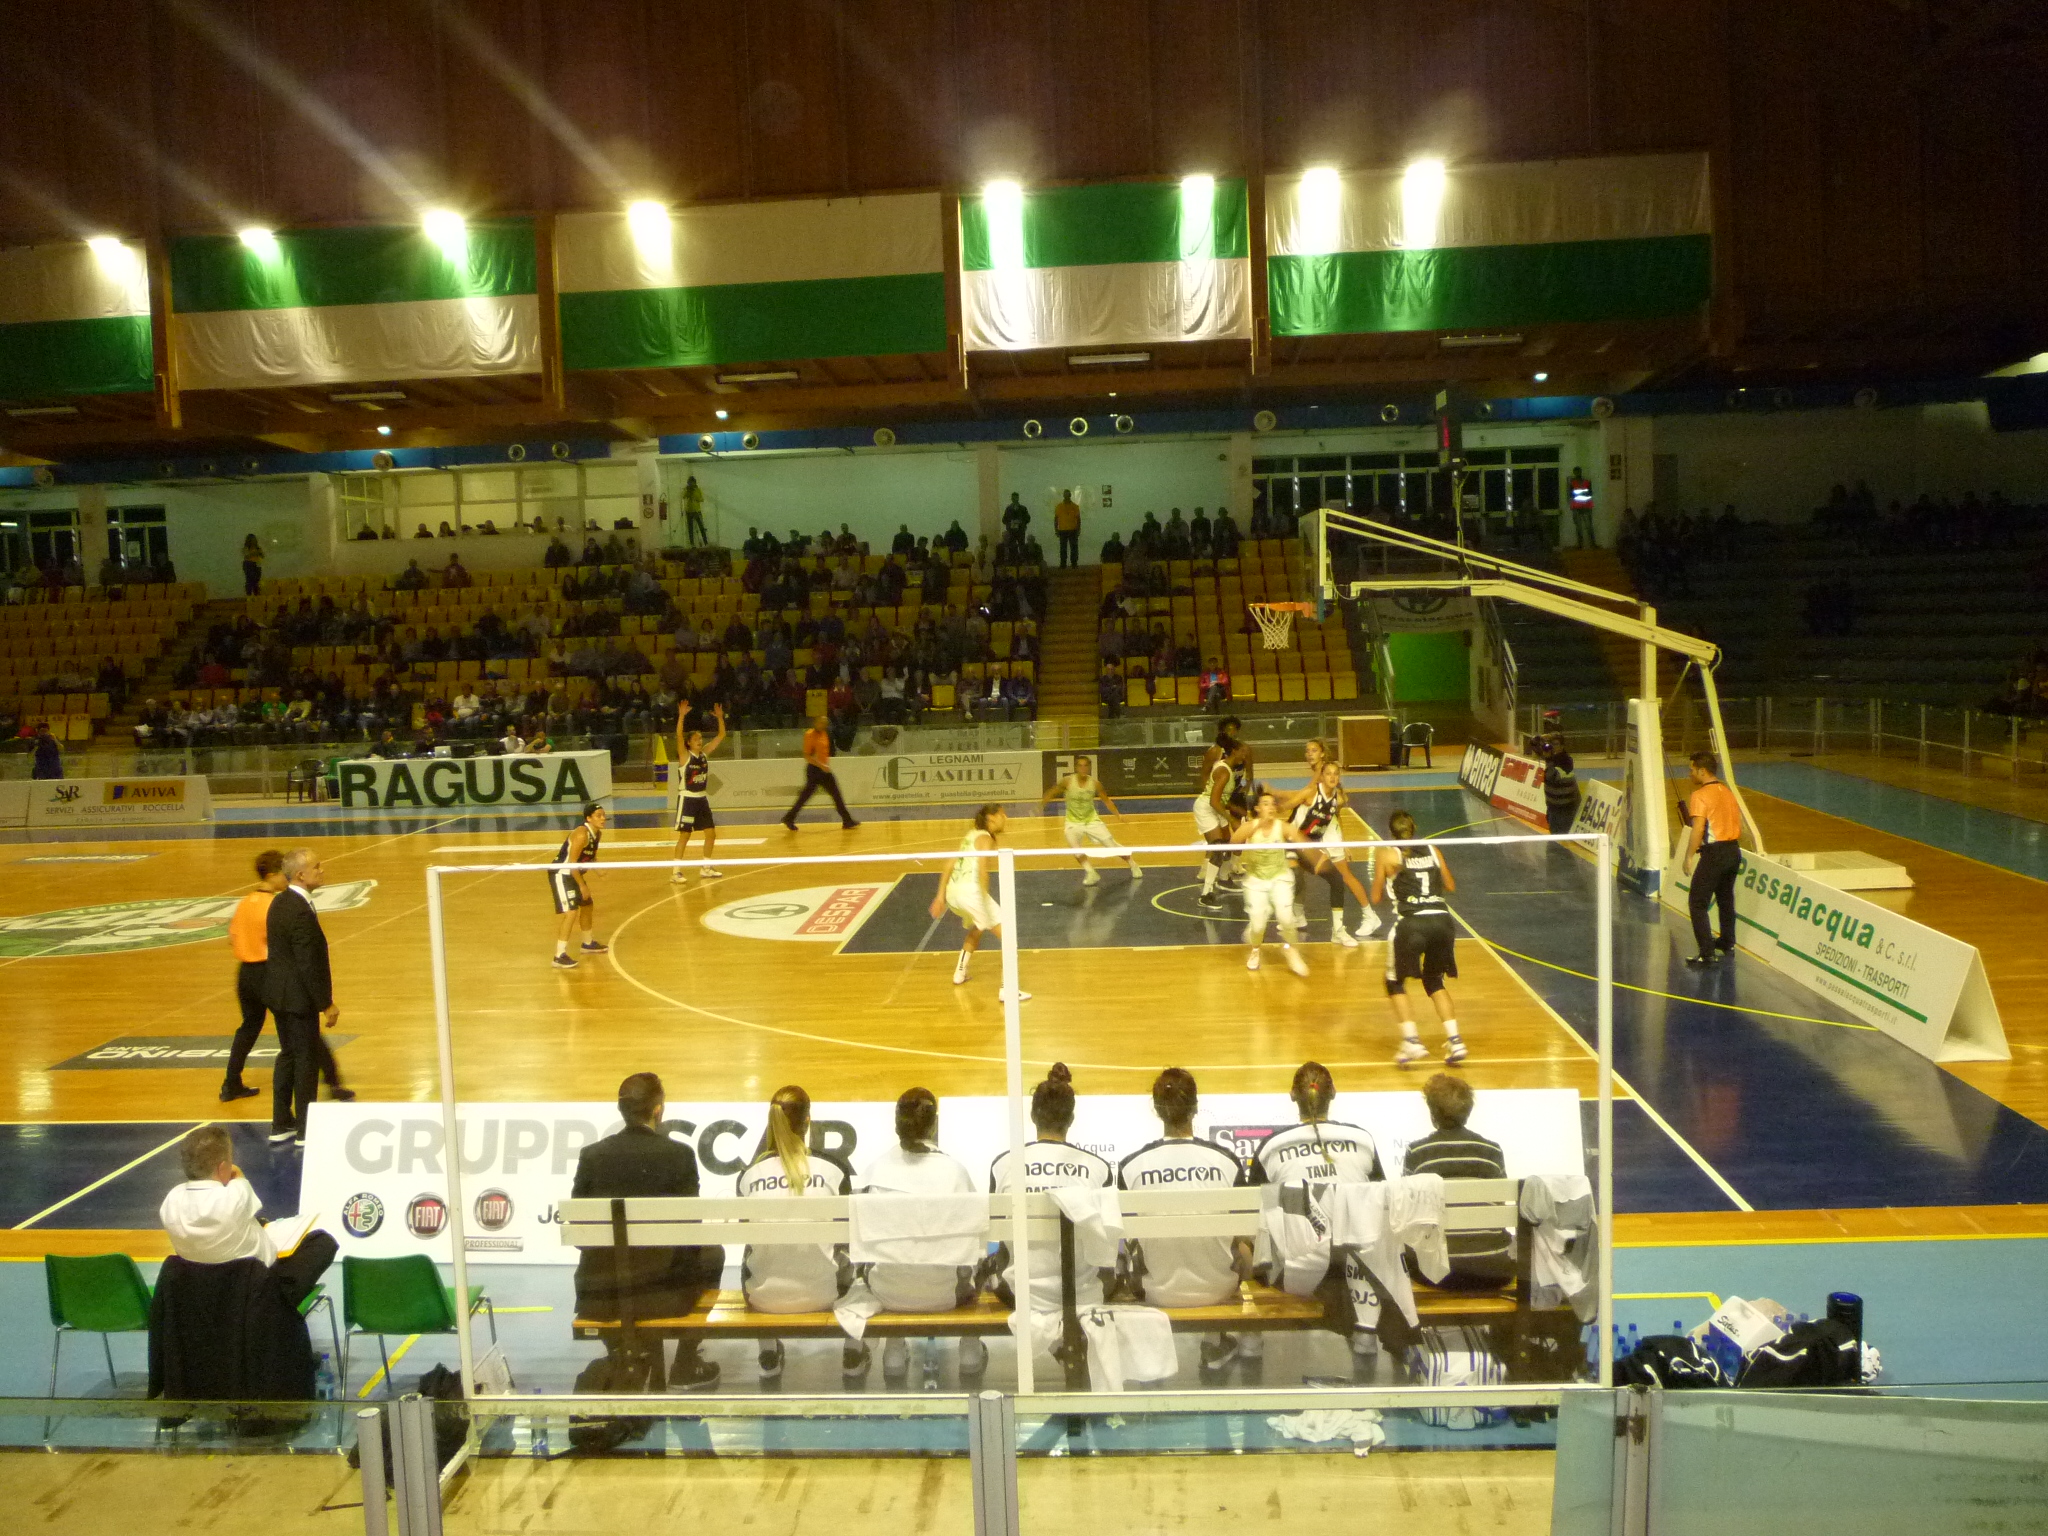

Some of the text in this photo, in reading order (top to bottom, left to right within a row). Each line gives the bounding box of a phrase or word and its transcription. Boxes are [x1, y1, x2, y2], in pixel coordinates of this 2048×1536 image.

[929, 754, 984, 765] LEGNAMI
[342, 757, 592, 807] RAGUSA
[882, 756, 1013, 790] GUASTELLA
[131, 785, 177, 798] AVIVA
[45, 803, 185, 815] SERVIZI ASSICURATIVI ROCCELLA
[806, 889, 871, 933] DESPAR
[1815, 941, 1857, 974] SPEDIZIONI
[1863, 963, 1910, 1000] TRASPORTI
[344, 1119, 615, 1174] GRUPP
[1141, 1166, 1222, 1185] macron
[1306, 1163, 1337, 1179] TAVA
[415, 1206, 441, 1228] FIAT
[482, 1200, 506, 1220] FIAT
